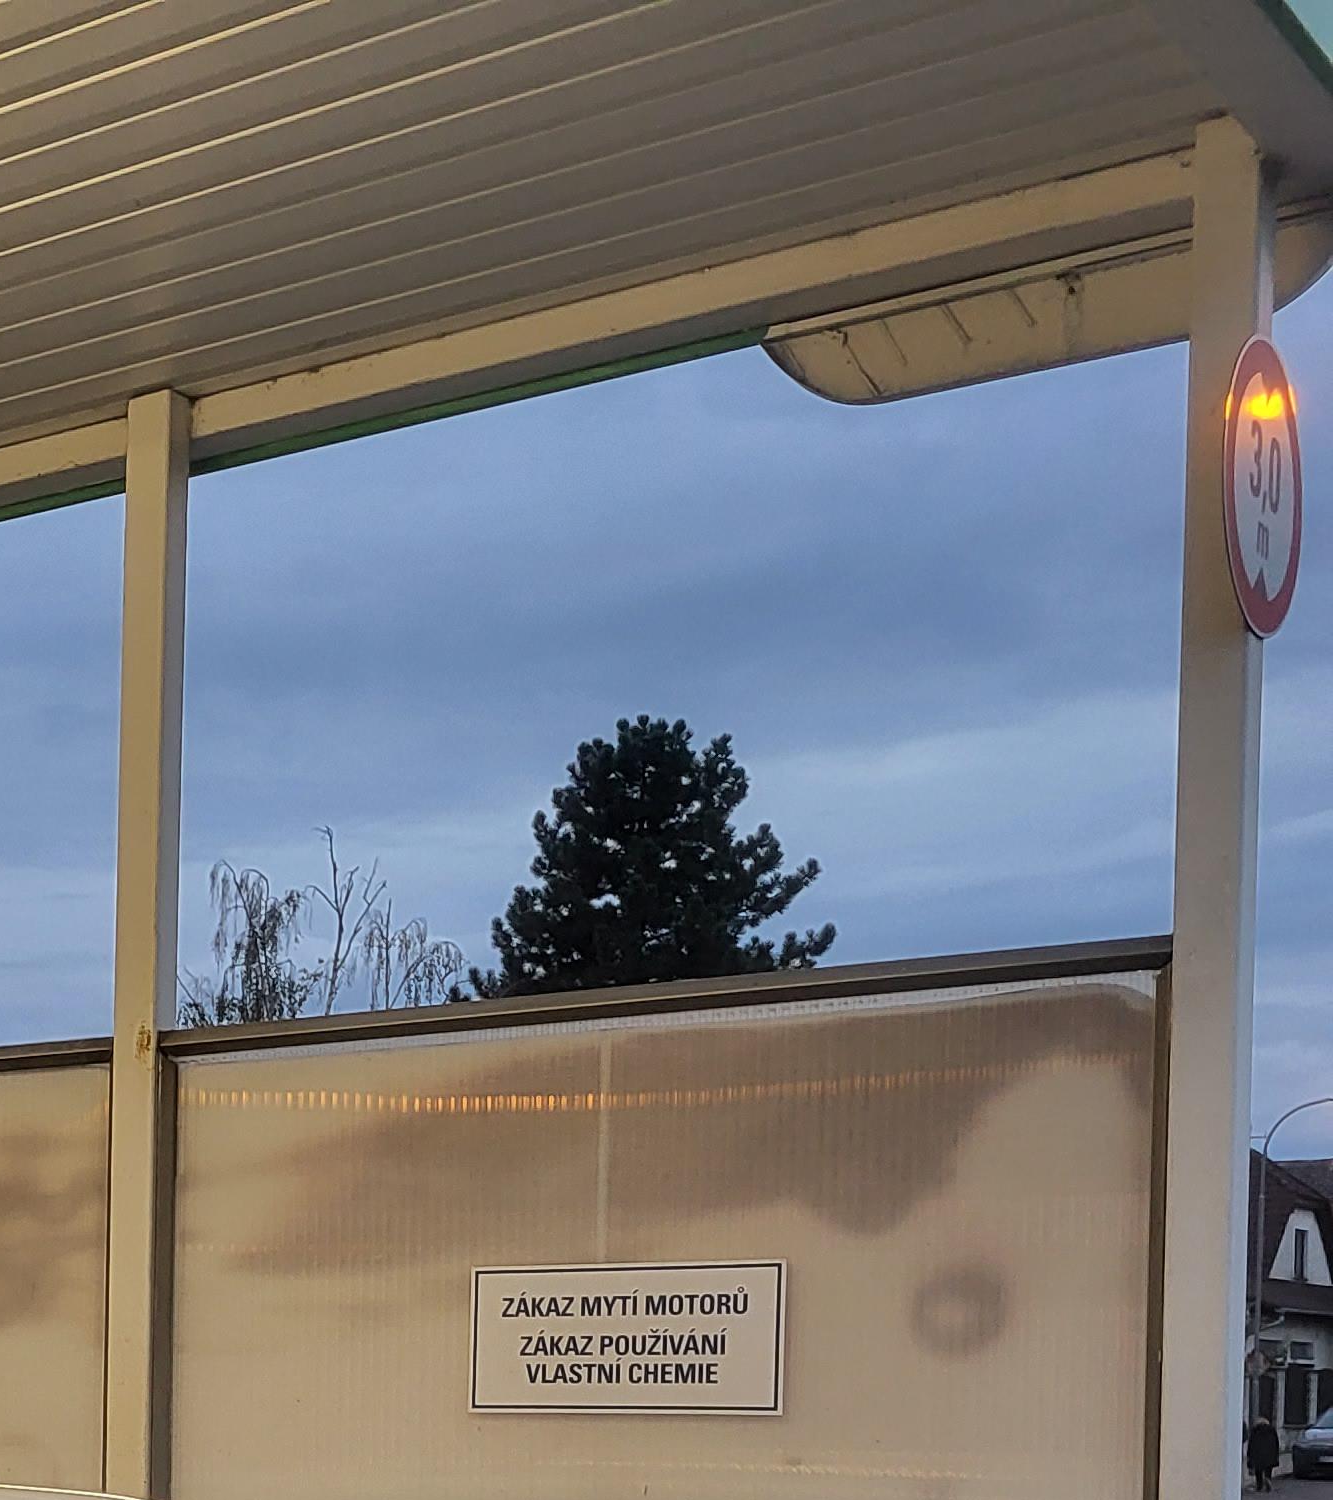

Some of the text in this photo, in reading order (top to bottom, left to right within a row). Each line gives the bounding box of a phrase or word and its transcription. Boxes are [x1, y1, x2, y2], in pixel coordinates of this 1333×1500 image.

[1250, 420, 1282, 515] 3,0
[1256, 521, 1270, 561] m
[501, 1286, 749, 1318] ZÁKAZ MYTÍ MOTORŮ
[519, 1328, 727, 1357] ZÁKAZ POUŽÍVÁNÍ
[526, 1357, 718, 1385] VLASTNÍ CHEMIE
